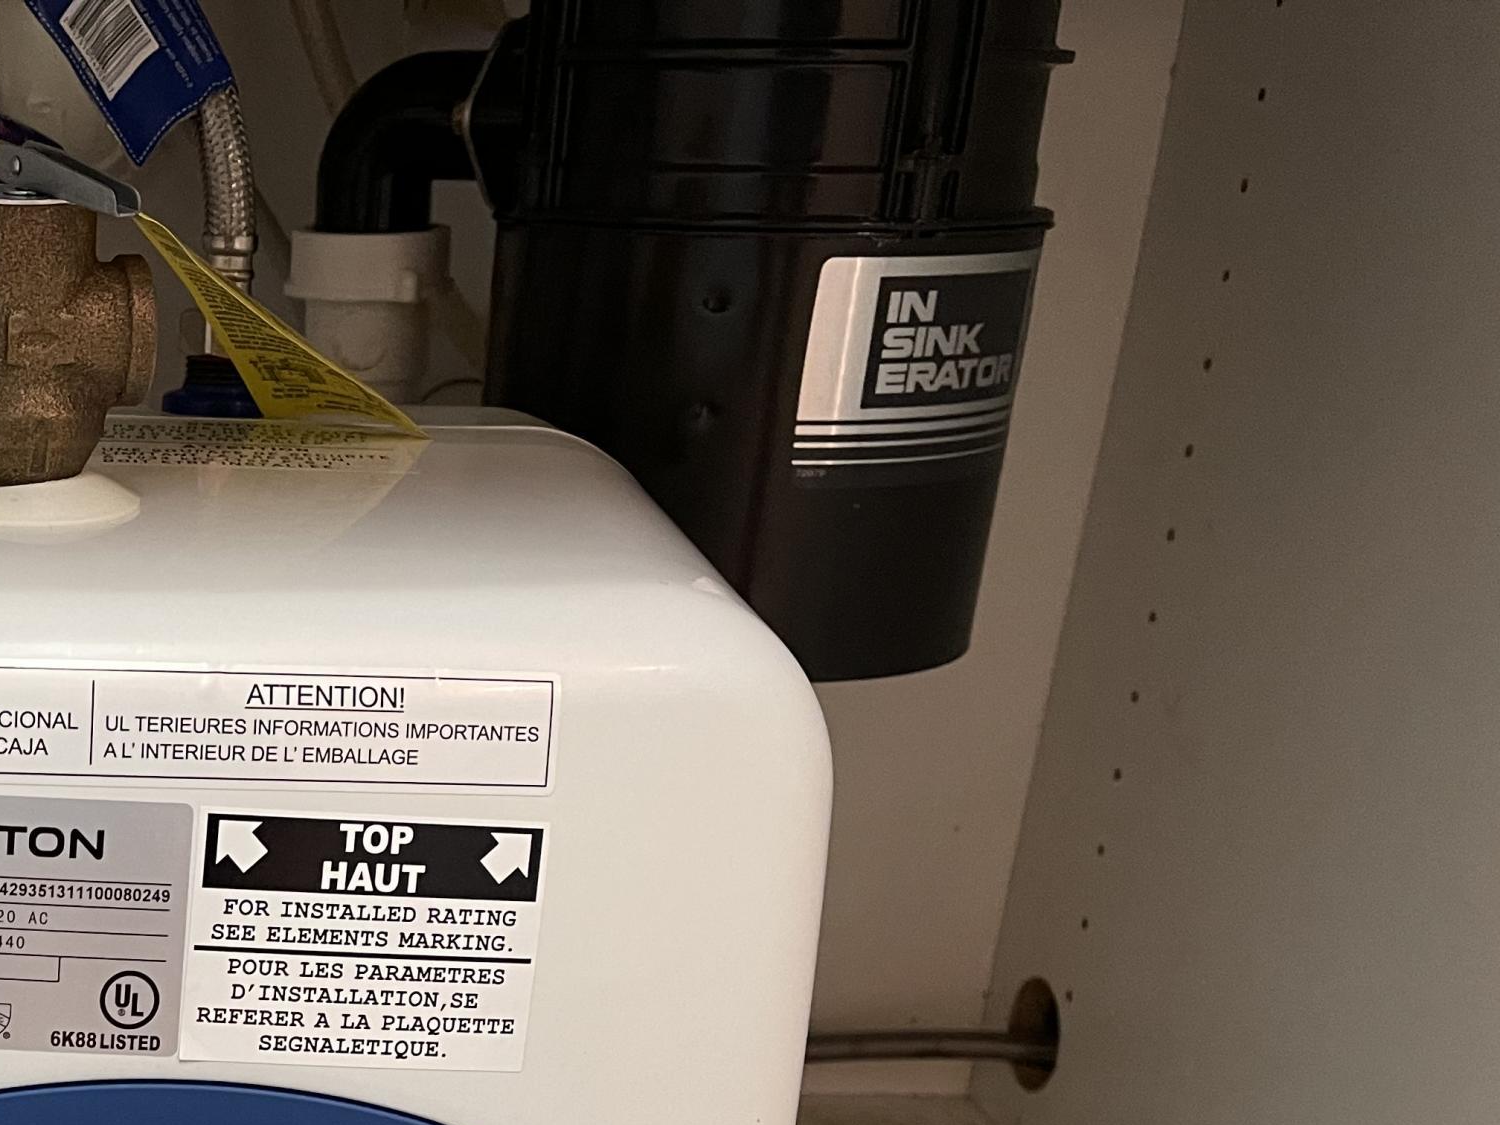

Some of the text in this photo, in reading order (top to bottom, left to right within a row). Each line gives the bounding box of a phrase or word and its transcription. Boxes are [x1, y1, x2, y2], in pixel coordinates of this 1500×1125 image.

[887, 291, 937, 323] IN
[881, 323, 985, 359] SINK
[875, 353, 1012, 394] ERATOR
[247, 684, 404, 708] ATTENTION!
[106, 716, 538, 742] UL TERIEURES INFORMATIONS IMPORTANTES
[104, 743, 116, 758] A
[141, 743, 245, 761] INTERIEUR
[252, 746, 277, 761] DE
[303, 747, 418, 765] EMBALLAGE
[340, 824, 413, 854] TOP
[321, 861, 425, 893] HAUT
[28, 912, 47, 925] AC
[223, 899, 516, 926] FOR INSTALLED RATING
[211, 924, 512, 952] SEE ELEMENTS MARKING.
[228, 959, 505, 984] POUR LES PARAMETRES
[115, 984, 144, 1017] UL
[196, 1007, 514, 1035] REFERER A LA PLAQUETTE
[51, 1031, 160, 1051] 6K88 LISTED
[259, 1035, 446, 1059] SEGNALETIQUE.
